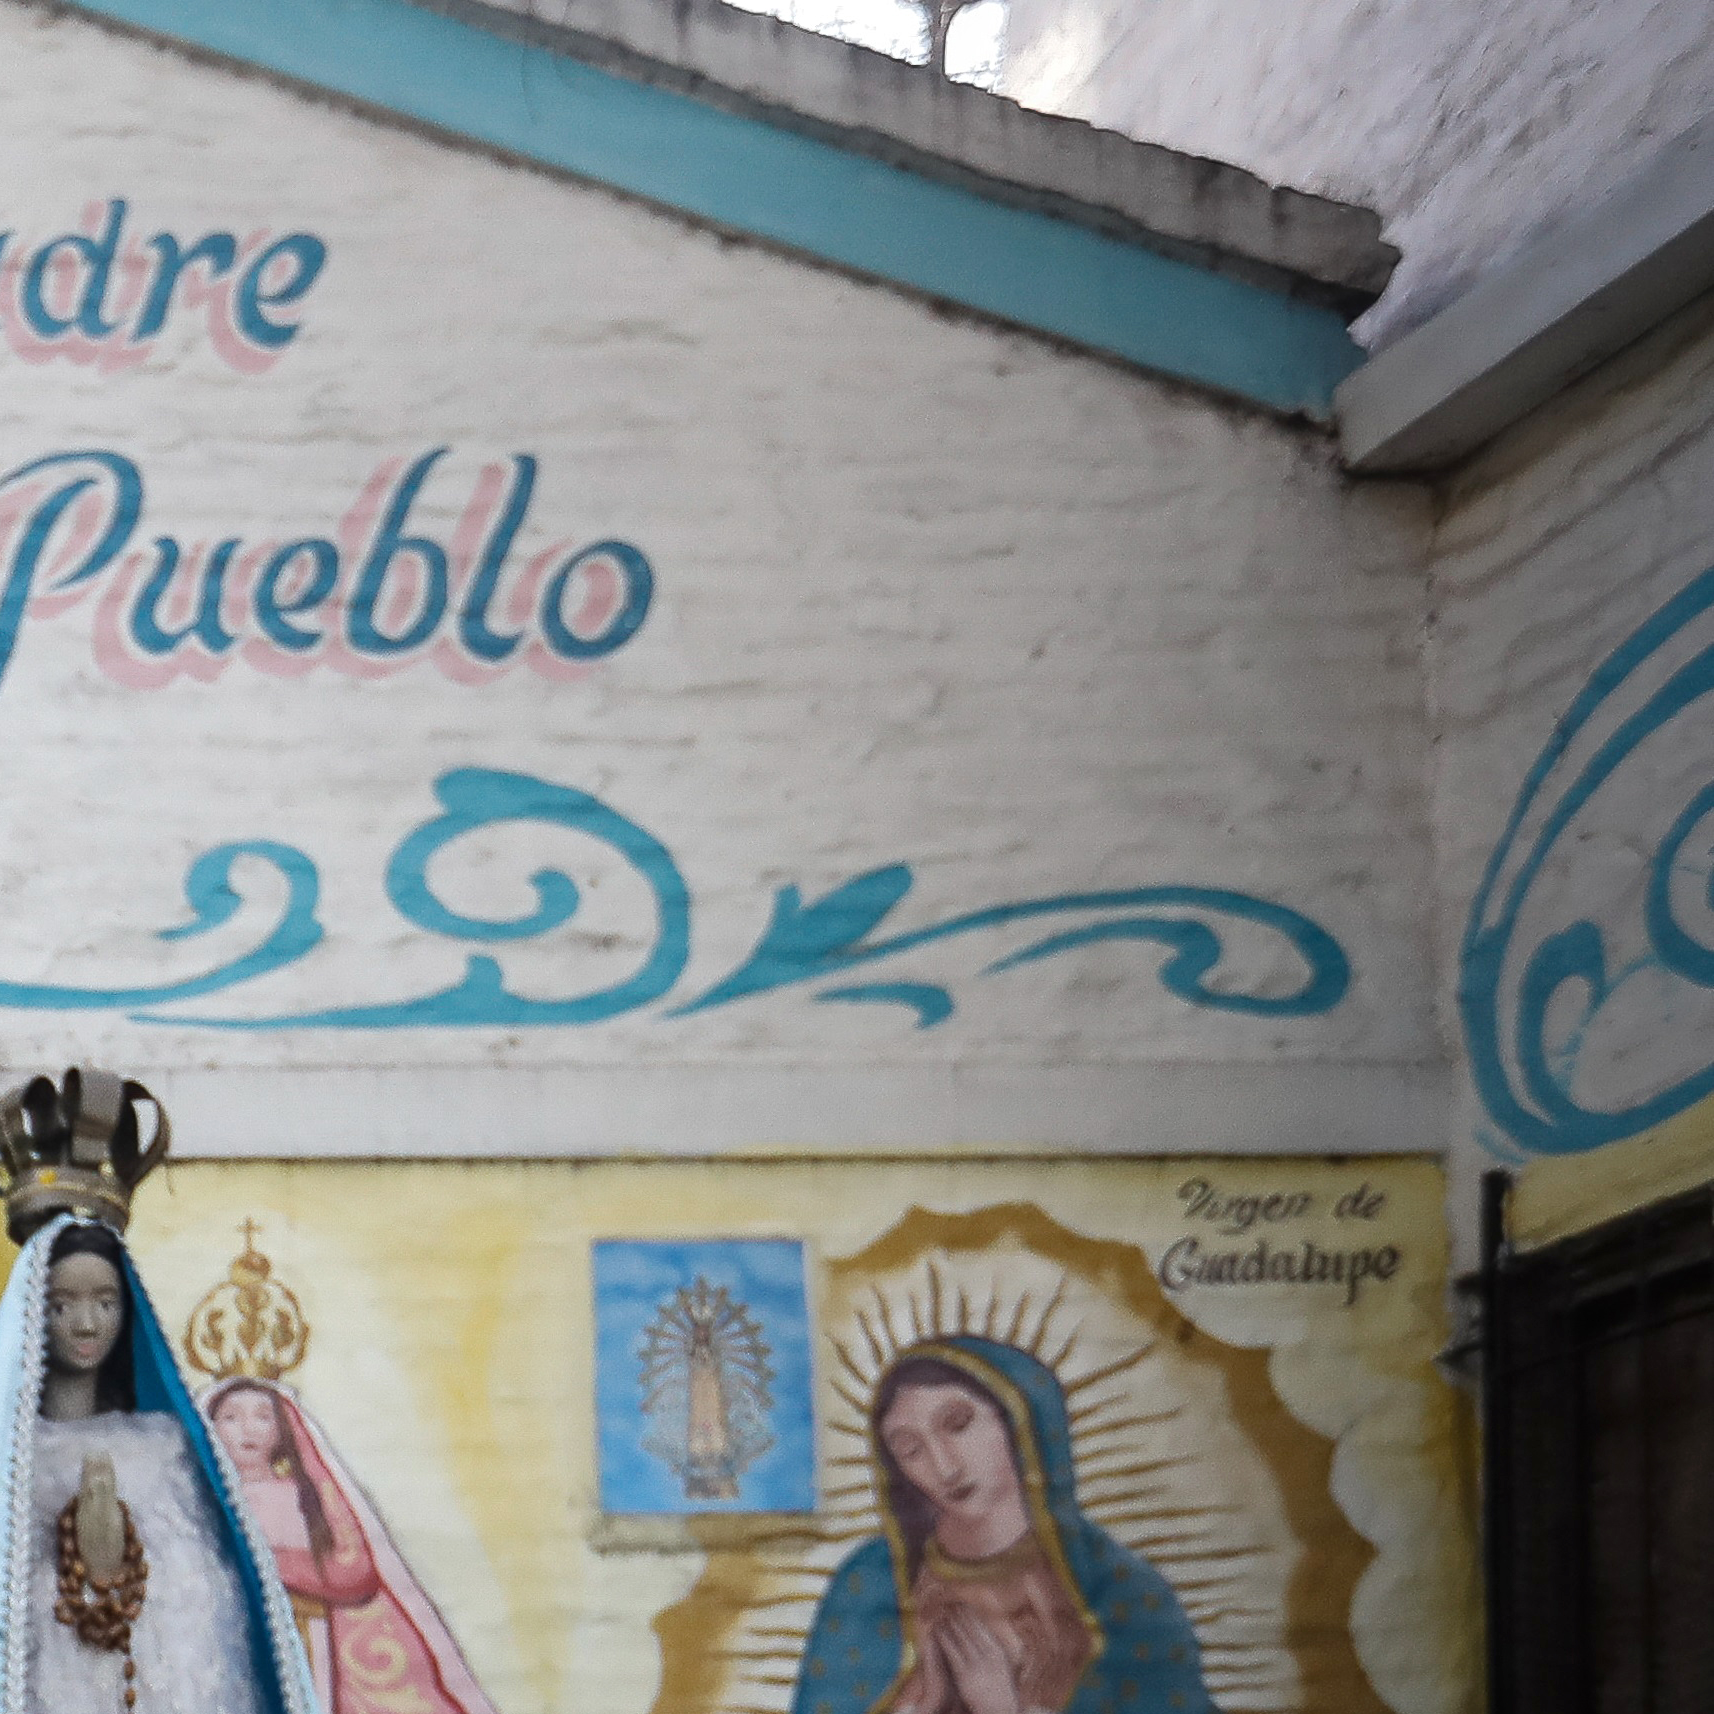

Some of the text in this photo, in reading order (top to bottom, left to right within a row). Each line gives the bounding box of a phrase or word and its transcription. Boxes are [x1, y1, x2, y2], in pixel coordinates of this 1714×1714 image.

[1176, 1176, 1387, 1236] Virgen de
[1157, 1235, 1404, 1309] Guadalupe
